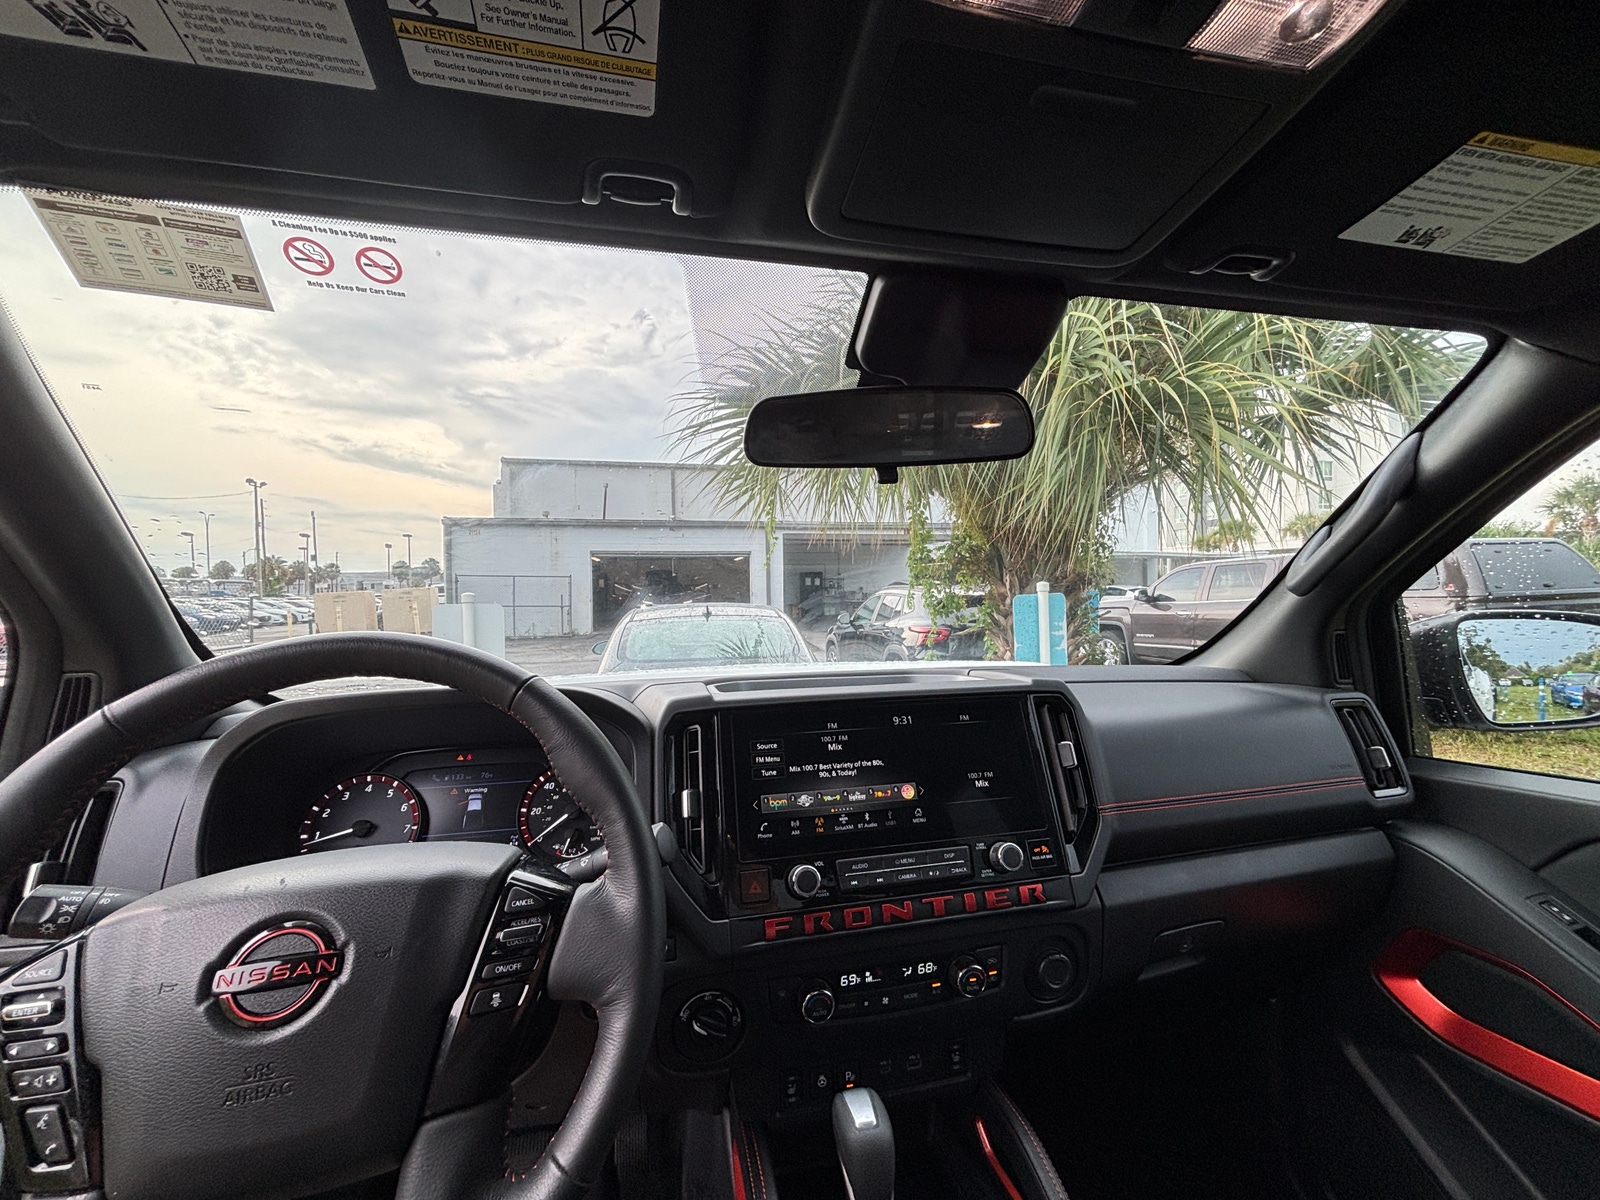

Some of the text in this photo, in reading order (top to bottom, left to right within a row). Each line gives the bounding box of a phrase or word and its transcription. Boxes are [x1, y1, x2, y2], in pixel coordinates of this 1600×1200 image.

[484, 3, 569, 26] See Owner's Manual
[480, 12, 576, 38] For Further Information.
[412, 25, 519, 54] AVERTISSEMENT
[546, 51, 572, 63] GRAND
[573, 55, 600, 68] RISQUE
[600, 61, 611, 71] DE
[611, 64, 652, 76] CULBUTAGE
[424, 43, 450, 57] Évitez
[451, 48, 465, 59] les
[515, 60, 552, 75] brusques
[553, 67, 561, 76] et
[562, 67, 570, 76] la
[571, 70, 598, 82] vitesse
[599, 75, 637, 88] excessive.
[433, 59, 466, 72] Bouclez
[467, 65, 500, 78] toujours
[500, 71, 521, 81] votre
[521, 75, 552, 86] ceinture
[553, 78, 561, 86] et
[561, 80, 579, 90] celle
[580, 83, 593, 92] des
[412, 68, 466, 84] Reportez-vous
[467, 78, 476, 86] au
[477, 79, 504, 90] Manuel
[504, 83, 514, 92] de
[542, 90, 558, 99] pour
[559, 91, 569, 99] un
[271, 219, 397, 244] A Cleaning Fee Up to $500 applies
[306, 280, 324, 289] Help
[325, 282, 335, 290] Us
[335, 283, 354, 293] Keep
[369, 287, 386, 296] Cars
[386, 289, 407, 298] Clean
[892, 715, 913, 726] 9:31
[959, 714, 970, 722] FM
[827, 722, 838, 730] FM
[820, 734, 849, 743] 100.7 FM
[756, 742, 778, 750] Source
[828, 743, 843, 752] Mix
[755, 755, 781, 764] FM Menu
[789, 765, 801, 774] Mix
[801, 763, 818, 773] 100.7
[818, 762, 833, 771] Best
[832, 761, 854, 771] Variety
[854, 760, 862, 768] of
[861, 760, 872, 768] the
[451, 773, 465, 781] 133
[760, 769, 778, 777] Tune
[831, 770, 837, 778] &
[837, 768, 858, 779] Today!
[967, 771, 994, 780] 100.7 FM
[364, 783, 373, 794] 4
[464, 786, 488, 794] Warning
[543, 781, 555, 790] 40
[974, 780, 990, 789] Mix
[341, 790, 351, 802] 3
[386, 788, 395, 799] 5
[400, 801, 409, 813] 6
[768, 796, 788, 811] bpm
[321, 807, 332, 819] 2
[530, 806, 543, 817] 20
[864, 821, 878, 829] Audio
[912, 816, 927, 824] MENU
[403, 823, 412, 834] 7
[790, 829, 801, 837] AM
[314, 831, 321, 841] 1
[757, 832, 773, 840] Phone
[900, 857, 916, 865] MENU
[943, 852, 956, 860] DISP
[851, 862, 869, 871] AUDIO
[955, 866, 969, 874] BACK
[898, 873, 918, 881] CAMERA
[57, 895, 84, 903] AUTO
[511, 897, 536, 908] CANCEL
[763, 883, 1047, 941] FRONTIER
[510, 916, 542, 928] ACCEL/RES
[23, 968, 53, 979] SOURCE
[215, 956, 338, 990] NISSAN
[494, 962, 523, 974] ON/OFF
[903, 992, 919, 1000] MODE
[11, 1006, 40, 1018] ENTER
[243, 1060, 278, 1081] SRS
[222, 1081, 294, 1108] AIRBAG
